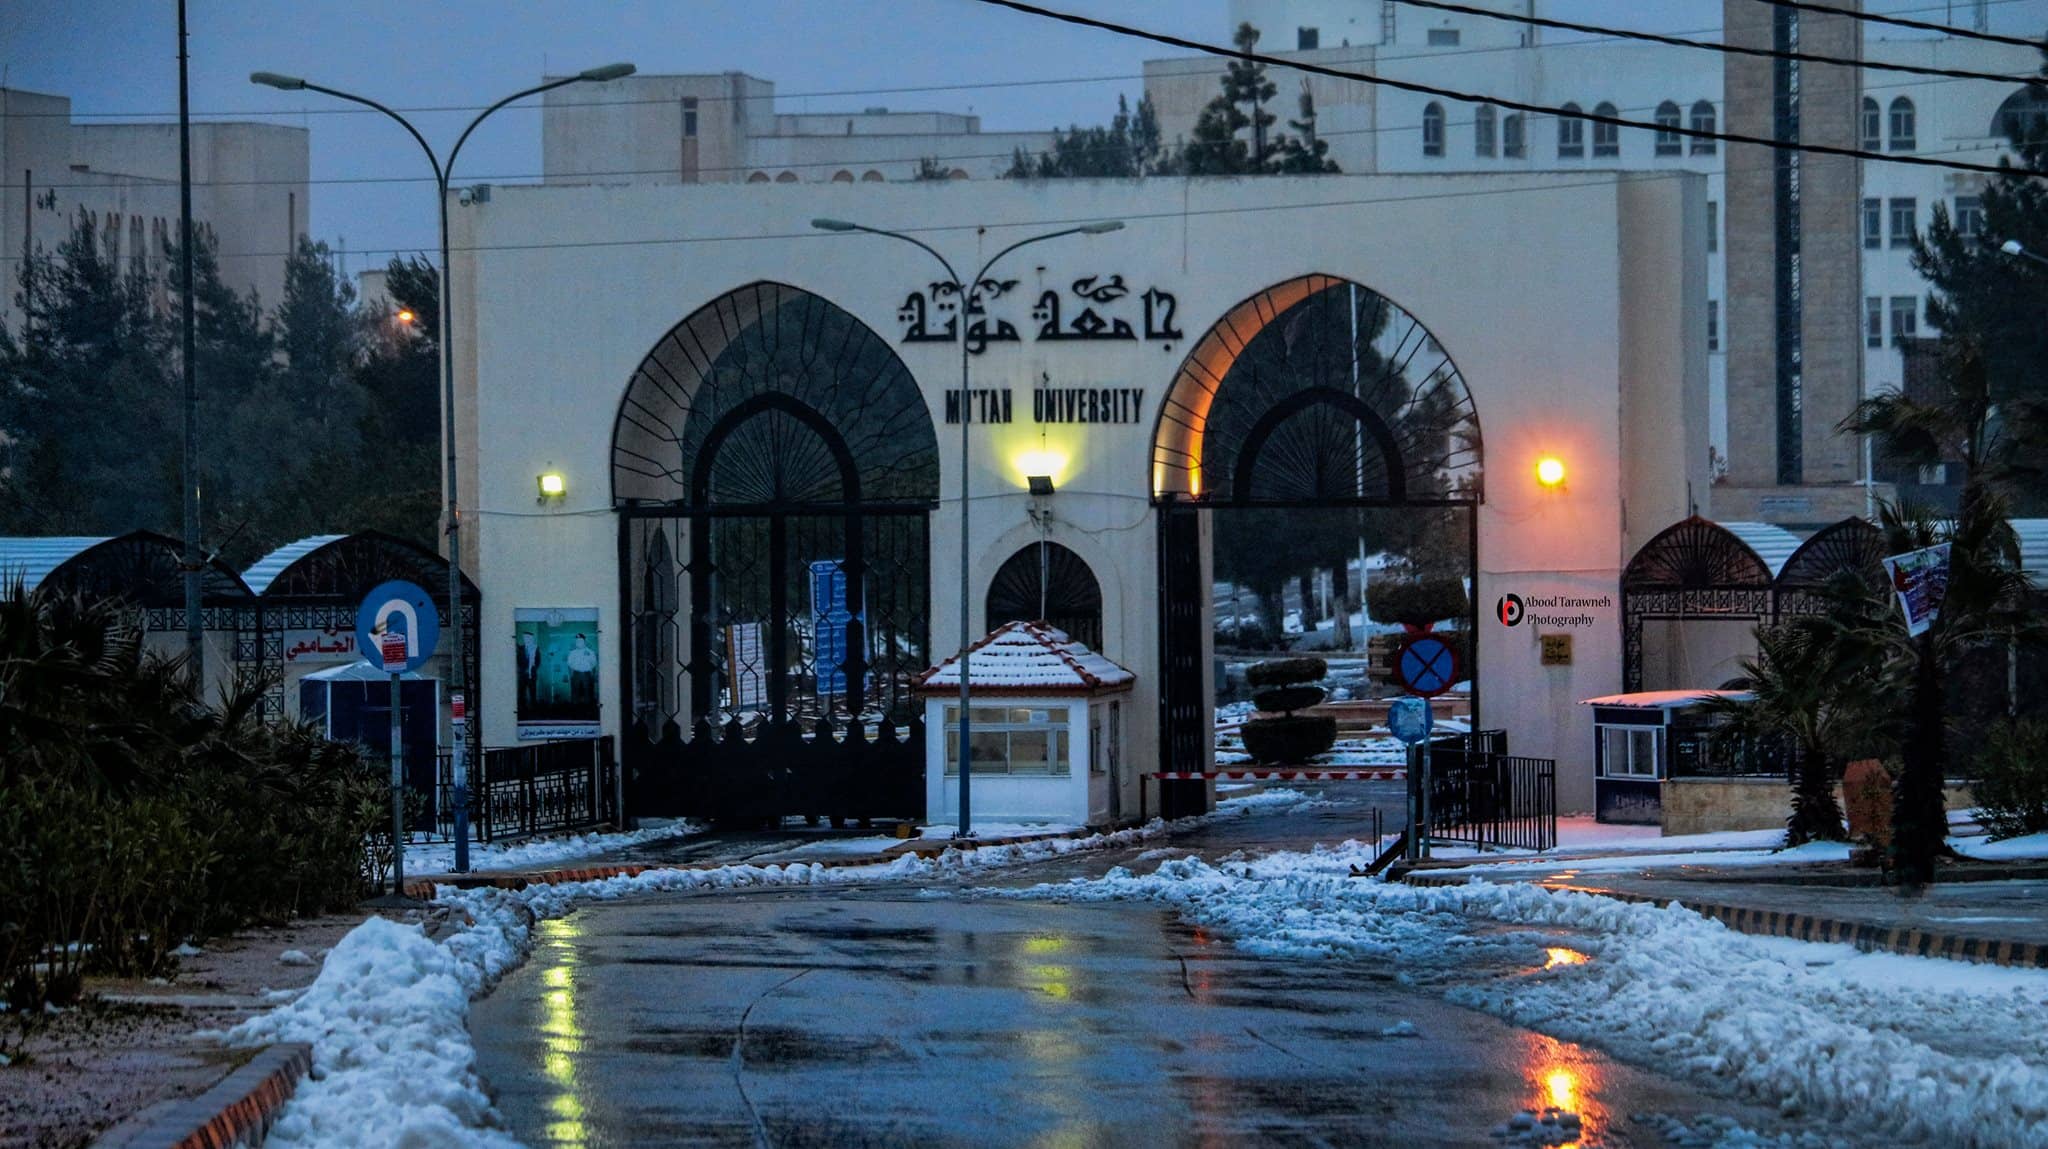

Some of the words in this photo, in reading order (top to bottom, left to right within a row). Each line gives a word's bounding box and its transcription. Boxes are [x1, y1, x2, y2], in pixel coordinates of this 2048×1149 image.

[1032, 275, 1183, 352] جامعة
[945, 389, 1012, 424] MU'TAH
[1033, 389, 1144, 424] UNIVERSITY
[286, 636, 354, 661] الجامعي
